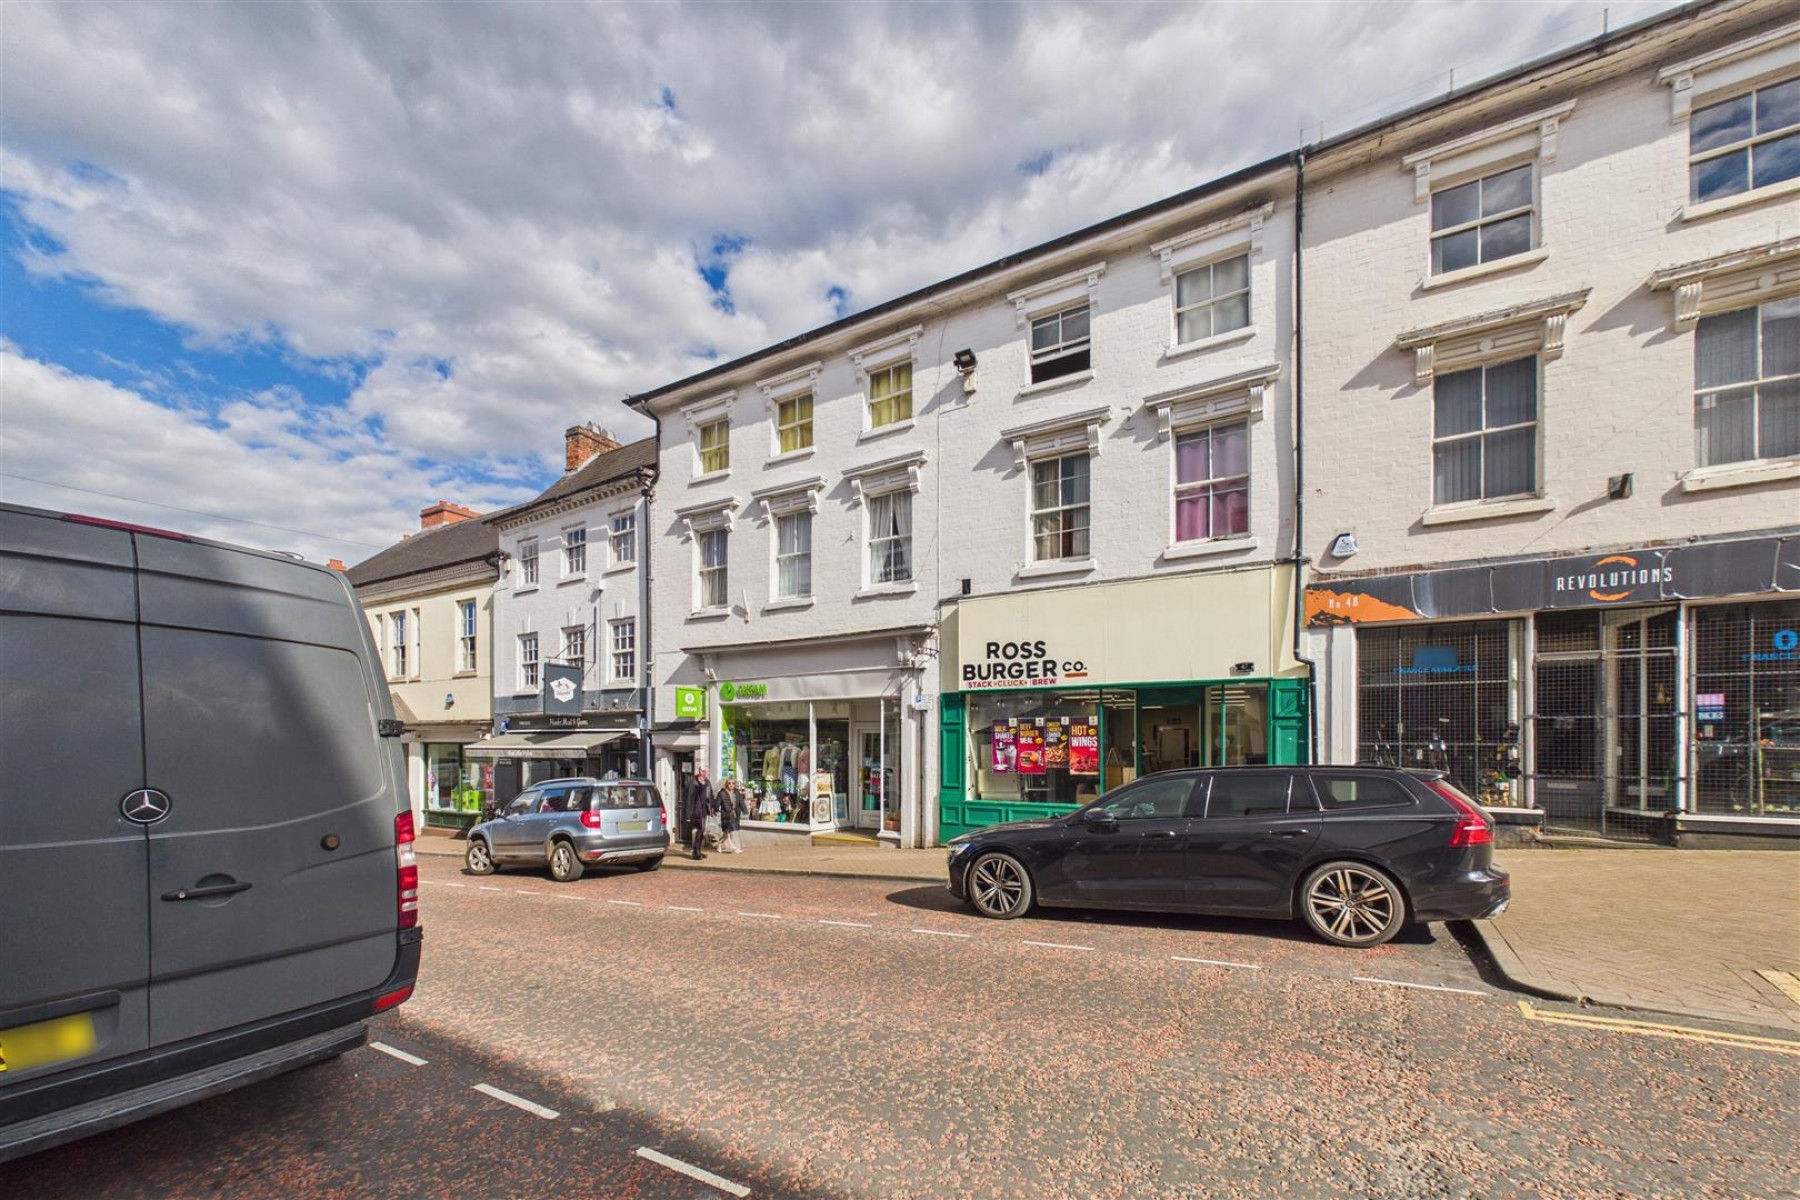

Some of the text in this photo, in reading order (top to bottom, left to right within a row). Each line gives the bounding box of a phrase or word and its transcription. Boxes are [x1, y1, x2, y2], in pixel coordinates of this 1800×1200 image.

[1556, 567, 1673, 591] REVOLUTIONS
[986, 640, 1046, 660] ROSS
[962, 659, 1088, 681] BURGER CO.
[968, 681, 993, 689] STACK
[1032, 678, 1057, 686] BREW
[1071, 725, 1087, 735] HOT
[1071, 736, 1097, 747] WINGS
